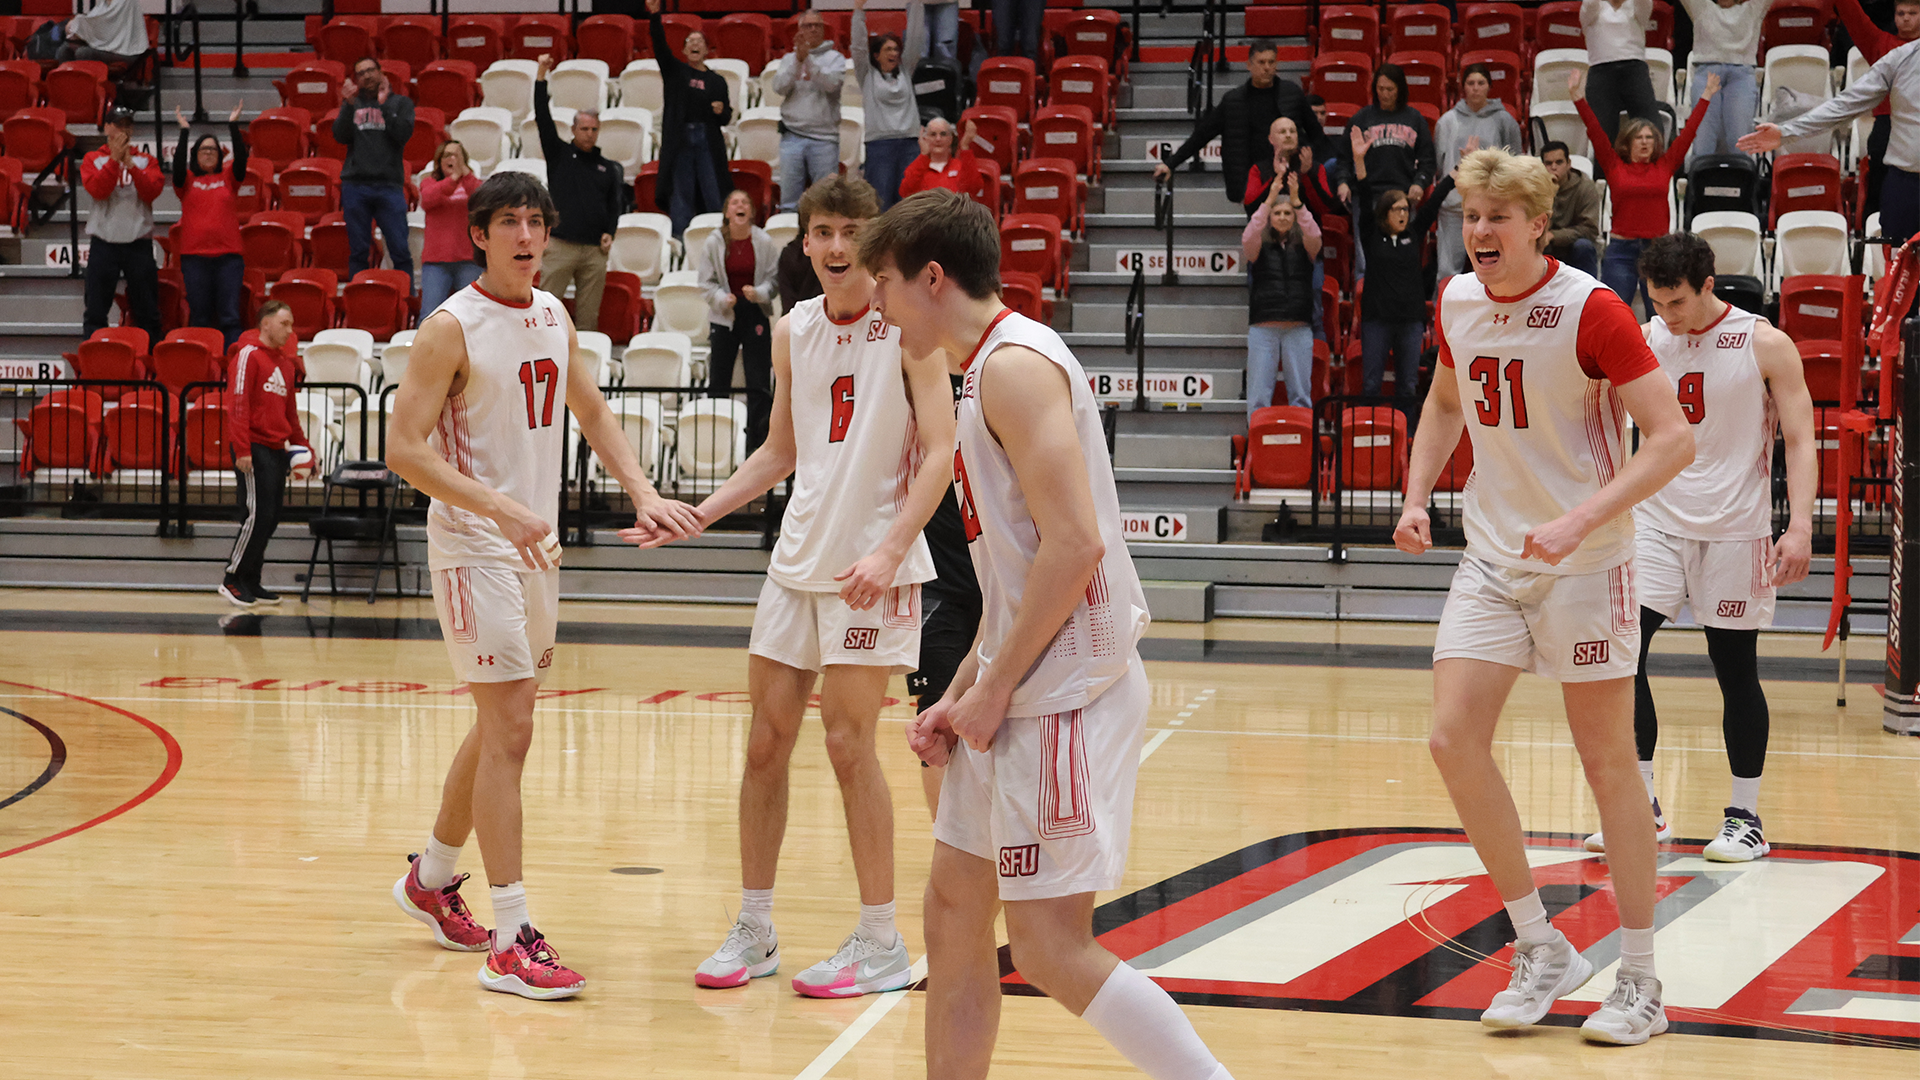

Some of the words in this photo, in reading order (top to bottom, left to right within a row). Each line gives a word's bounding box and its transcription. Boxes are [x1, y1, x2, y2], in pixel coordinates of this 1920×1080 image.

[59, 246, 71, 265] A
[1131, 252, 1144, 272] B
[1149, 256, 1206, 269] SETION
[1211, 252, 1224, 273] C
[1526, 305, 1565, 328] SFU
[1716, 331, 1748, 350] SFU
[39, 362, 51, 381] B
[518, 357, 560, 431] 17
[1099, 374, 1112, 395] B
[1183, 375, 1197, 397] C
[1469, 355, 1530, 430] 31
[828, 373, 856, 444] 6
[1676, 370, 1707, 426] 9
[1154, 514, 1170, 538] C
[1888, 505, 1905, 649] FRANCIS
[1716, 598, 1748, 618] SFU
[843, 627, 880, 650] SFU
[1573, 639, 1610, 666] SFU
[999, 842, 1040, 878] SFU
